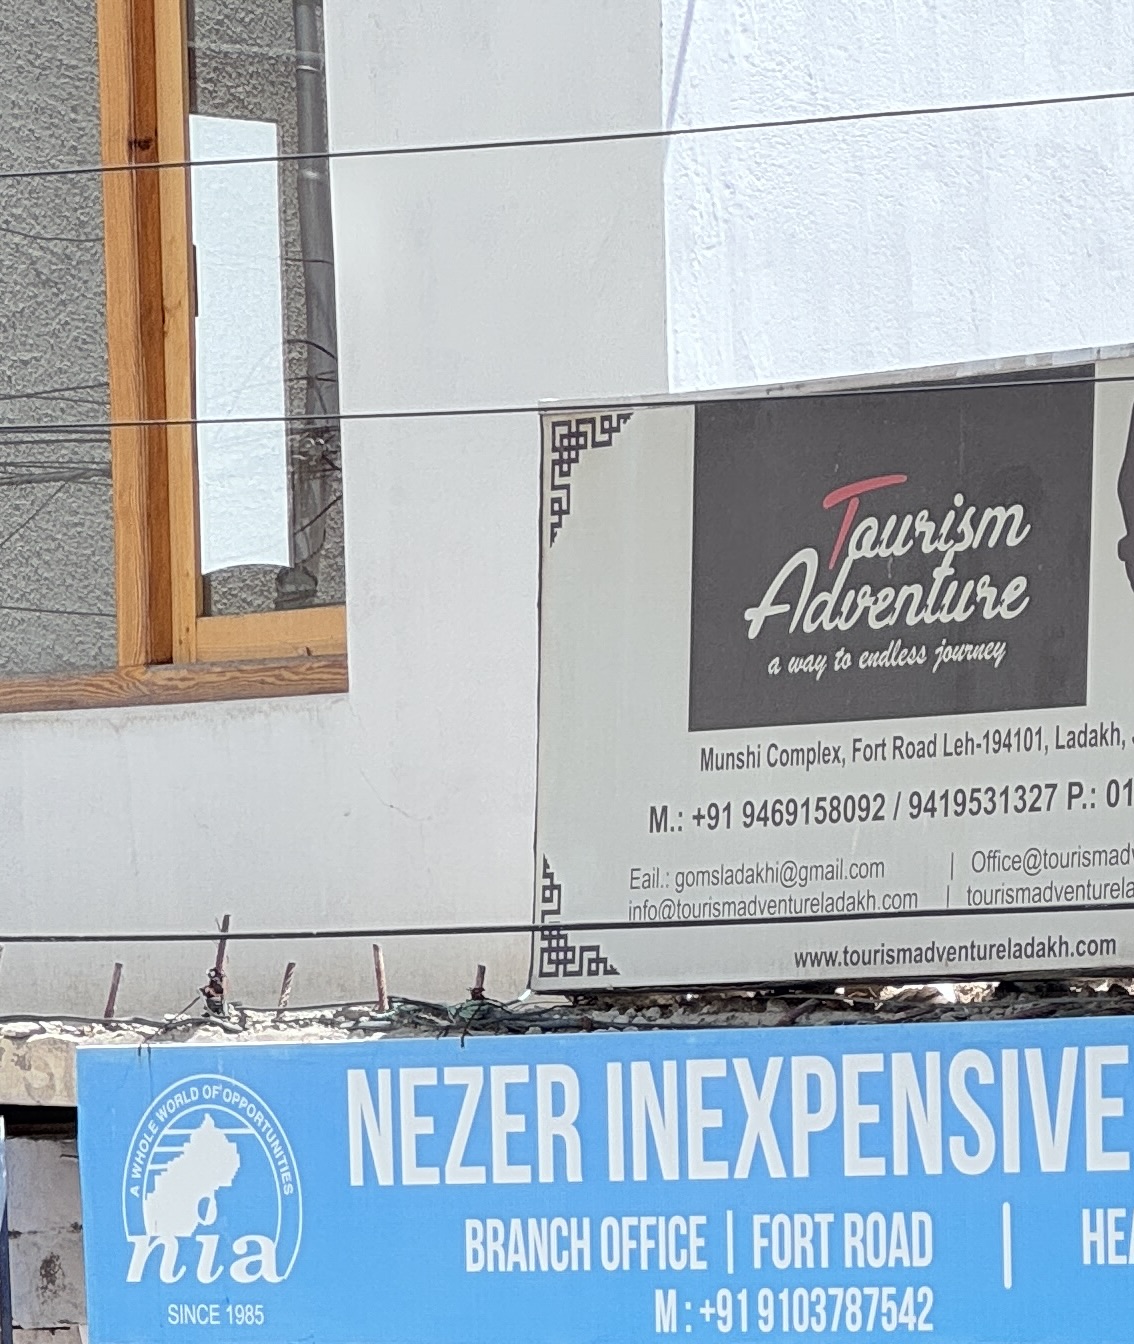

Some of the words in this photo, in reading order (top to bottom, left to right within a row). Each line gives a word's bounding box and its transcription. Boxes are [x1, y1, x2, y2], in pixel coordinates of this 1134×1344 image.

[823, 474, 1031, 569] Tourism
[744, 547, 1030, 639] Adventure
[768, 655, 781, 675] a
[787, 653, 827, 681] way
[834, 647, 852, 671] to
[859, 639, 927, 669] endless
[932, 638, 1006, 673] journey
[700, 744, 761, 772] Munshi
[766, 740, 846, 772] Complex,
[852, 737, 887, 763] Fort
[892, 733, 937, 760] Road
[943, 726, 1049, 757] Leh-194101,
[1055, 721, 1126, 750] Ladakh,
[692, 801, 731, 830] +91
[742, 793, 886, 829] 9469158092
[909, 784, 1058, 819] 9419531327
[675, 858, 885, 893] gomsladakhi@gmail.com
[628, 889, 918, 922] info@tourismadventureladakh.com
[794, 934, 1117, 968] www.tourismadventureladakh.com
[156, 1086, 199, 1122] WORLD
[202, 1084, 221, 1099] OF
[347, 1063, 583, 1187] NEZER
[606, 1045, 1130, 1182] INEXPENSIVE
[132, 1120, 159, 1181] WHOLE
[222, 1088, 294, 1196] OPPORTUNITIES
[129, 1185, 140, 1198] A
[126, 1234, 285, 1284] nia
[464, 1216, 591, 1273] BRANCH
[600, 1215, 708, 1272] OFFICE
[752, 1212, 835, 1270] FORT
[843, 1211, 933, 1269] ROAD
[167, 1304, 220, 1326] SINCE
[226, 1303, 265, 1326] 1985
[699, 1287, 748, 1333] +91
[757, 1285, 934, 1333] 9103787542
